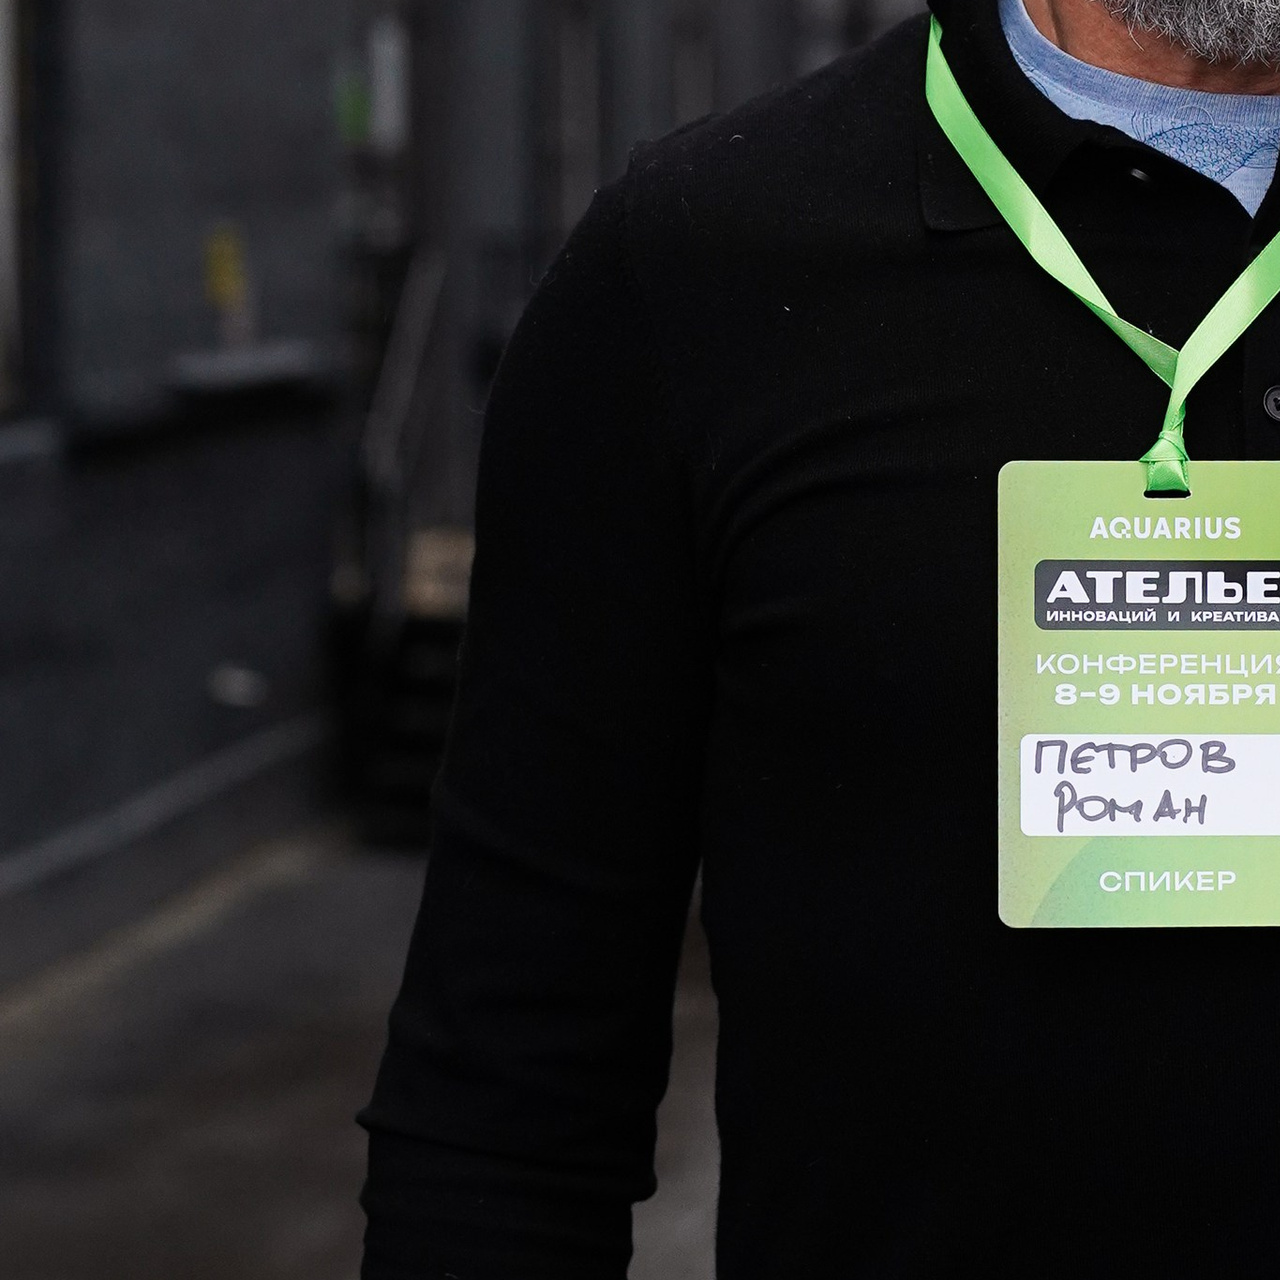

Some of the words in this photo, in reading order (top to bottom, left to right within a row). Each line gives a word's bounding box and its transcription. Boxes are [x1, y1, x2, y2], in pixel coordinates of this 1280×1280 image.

[1089, 516, 1241, 540] AQUARIUS
[1046, 570, 1280, 604] АТЕЛЬЕ
[1046, 608, 1157, 624] ИННОВАЦИЙ
[1167, 611, 1180, 622] И
[1191, 611, 1280, 622] КРЕАТИВА
[1131, 683, 1277, 706] НОЯБРЯ
[1034, 739, 1236, 774] ПЕТРОВ
[1054, 780, 1208, 833] РОМАН
[1099, 870, 1237, 893] СПИКЕР
